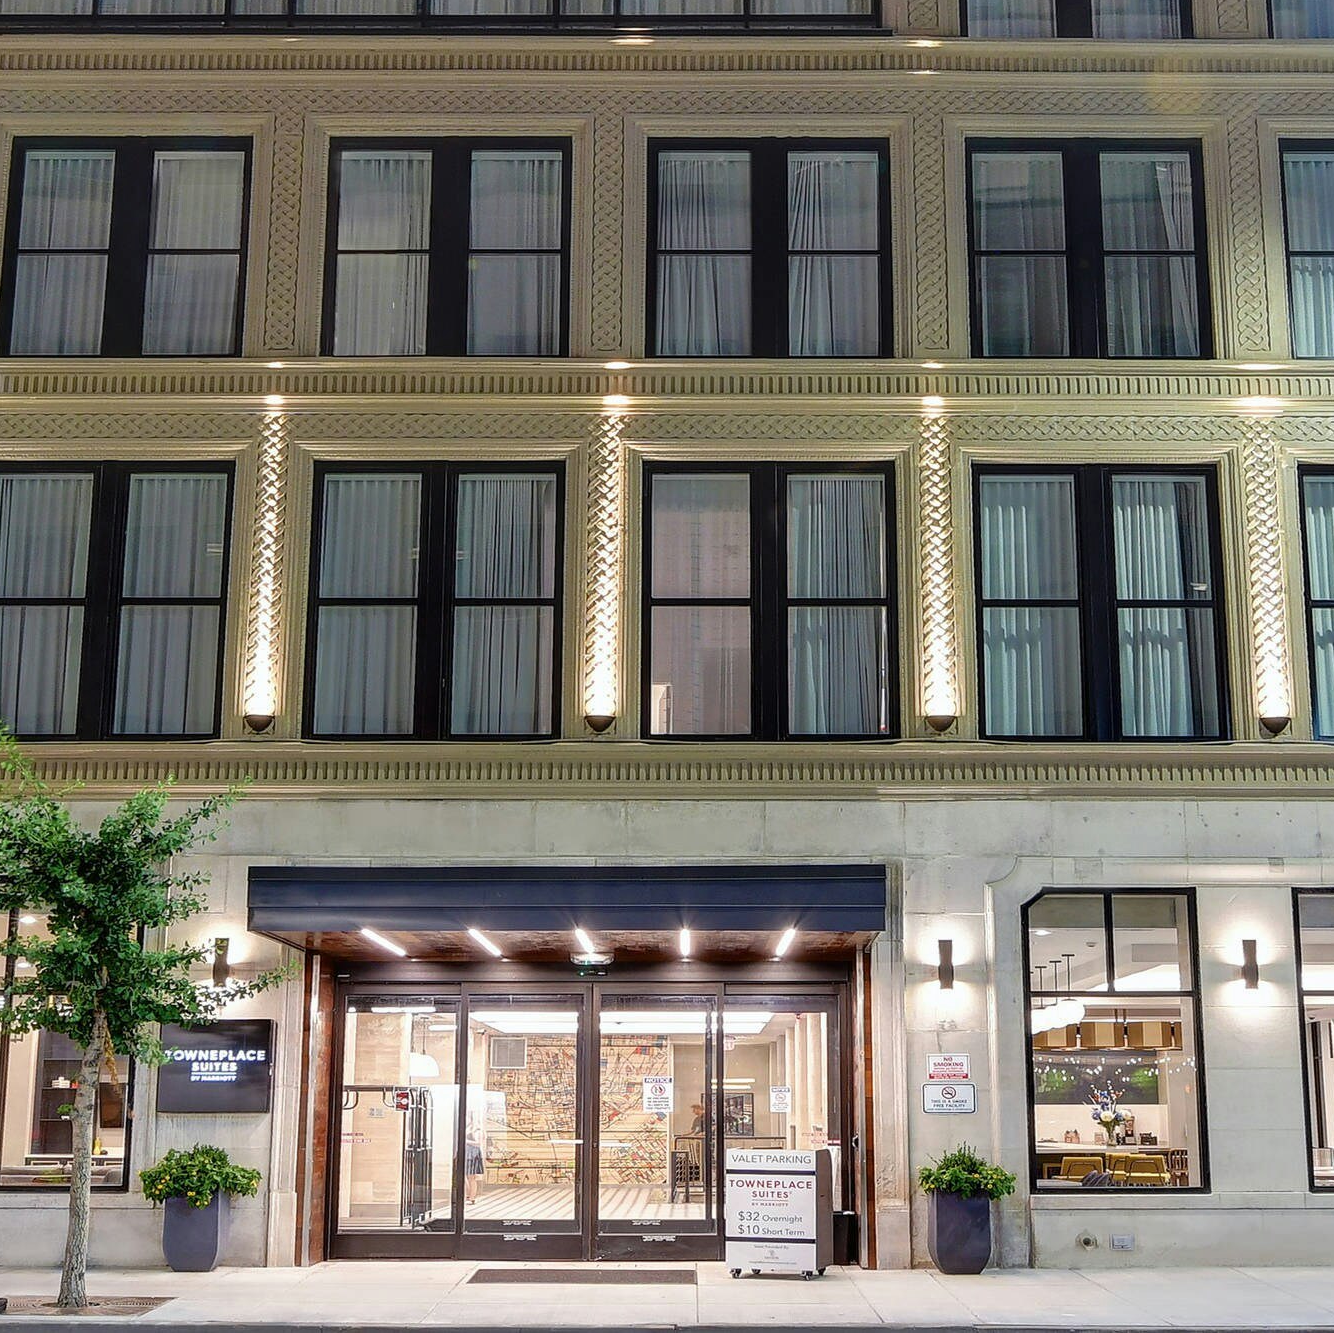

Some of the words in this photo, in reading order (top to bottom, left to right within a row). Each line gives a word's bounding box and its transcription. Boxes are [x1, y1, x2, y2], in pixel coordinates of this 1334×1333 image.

[164, 1049, 267, 1062] TOWNEPLACE
[191, 1061, 238, 1072] SUITES
[731, 1154, 763, 1163] VALET
[766, 1155, 812, 1164] PARKING
[729, 1179, 812, 1189] TOWNEPLACE
[752, 1190, 789, 1199] SUITES
[738, 1210, 760, 1222] $32
[762, 1214, 803, 1224] Overnight
[738, 1224, 760, 1235] $10
[762, 1227, 783, 1235] Short
[785, 1228, 805, 1236] Term
